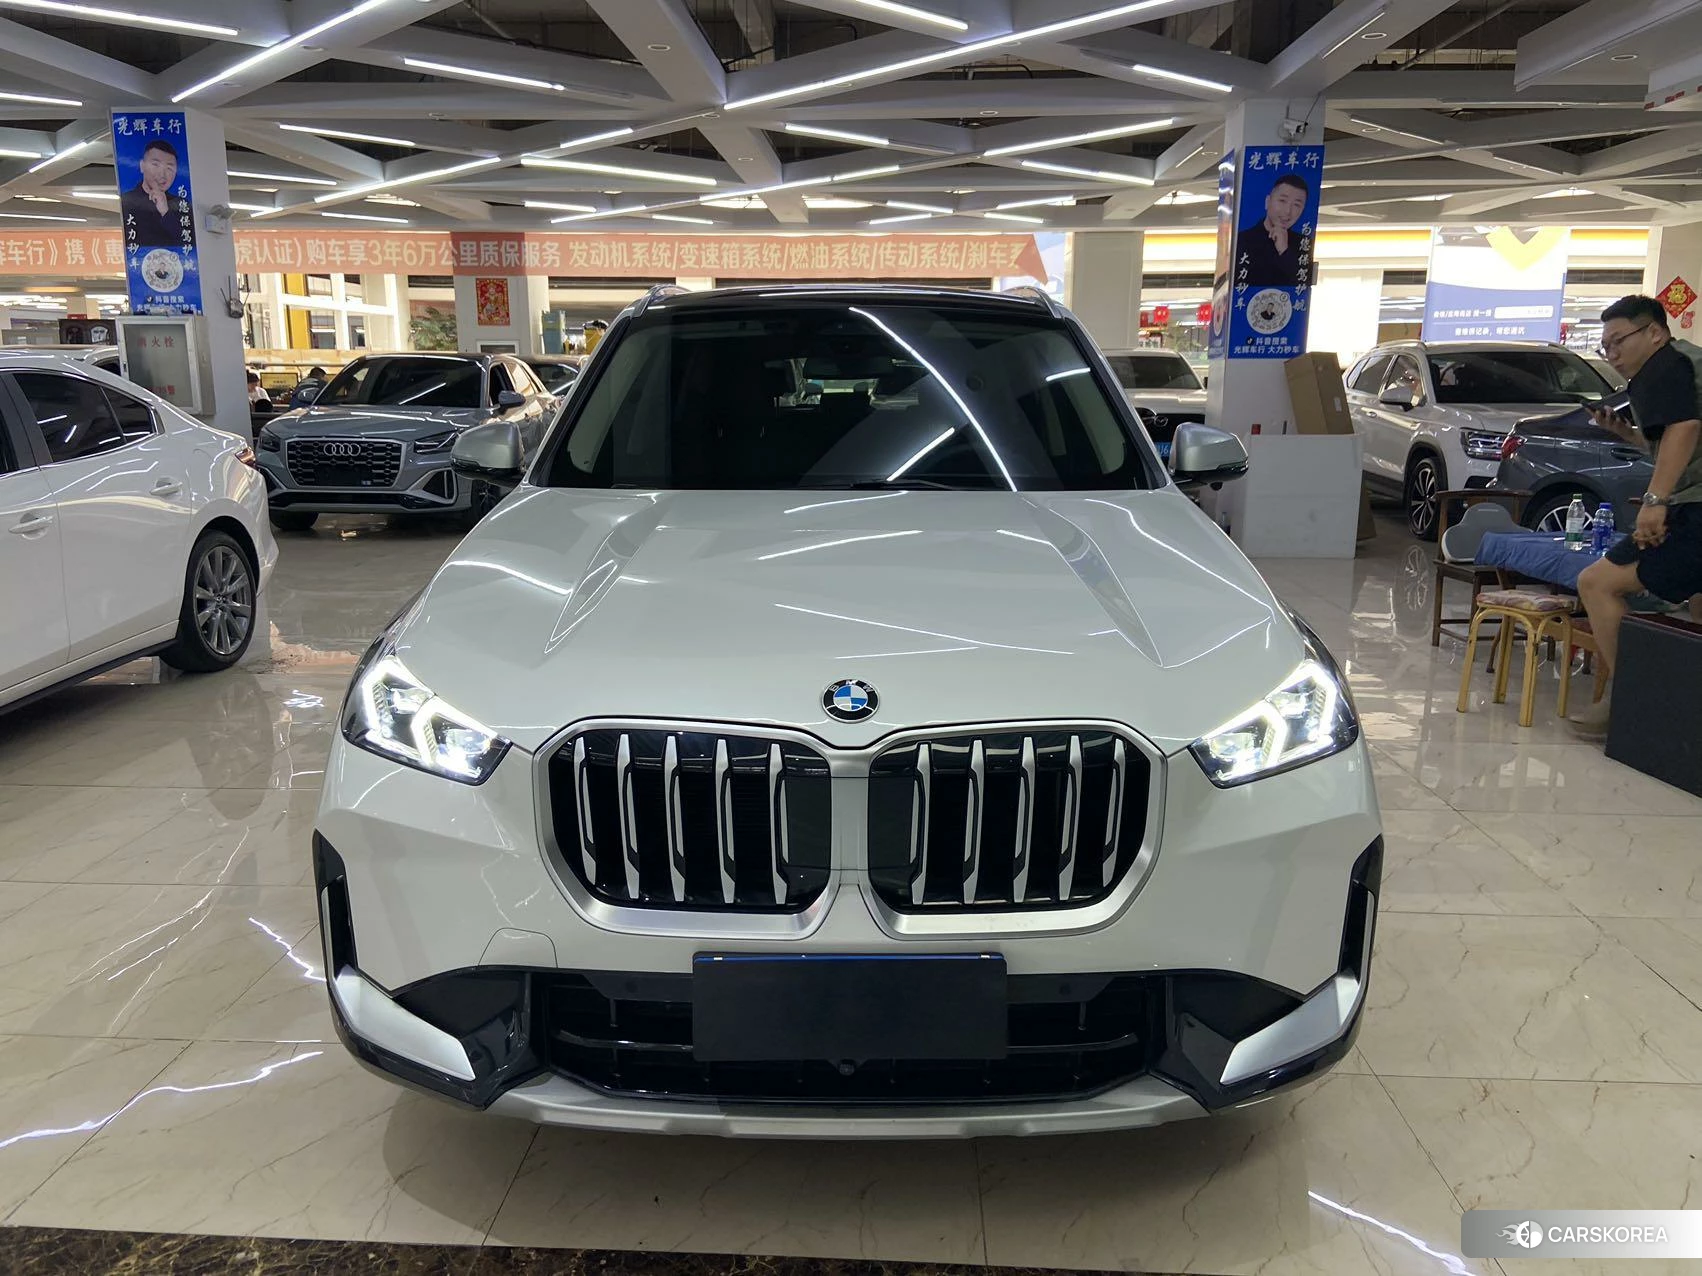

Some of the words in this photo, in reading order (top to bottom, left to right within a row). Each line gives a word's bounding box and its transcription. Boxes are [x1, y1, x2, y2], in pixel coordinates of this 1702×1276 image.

[117, 118, 182, 137] 光辉车行
[1248, 151, 1320, 170] 光辉车行
[1293, 222, 1313, 312] 为您保驾护航
